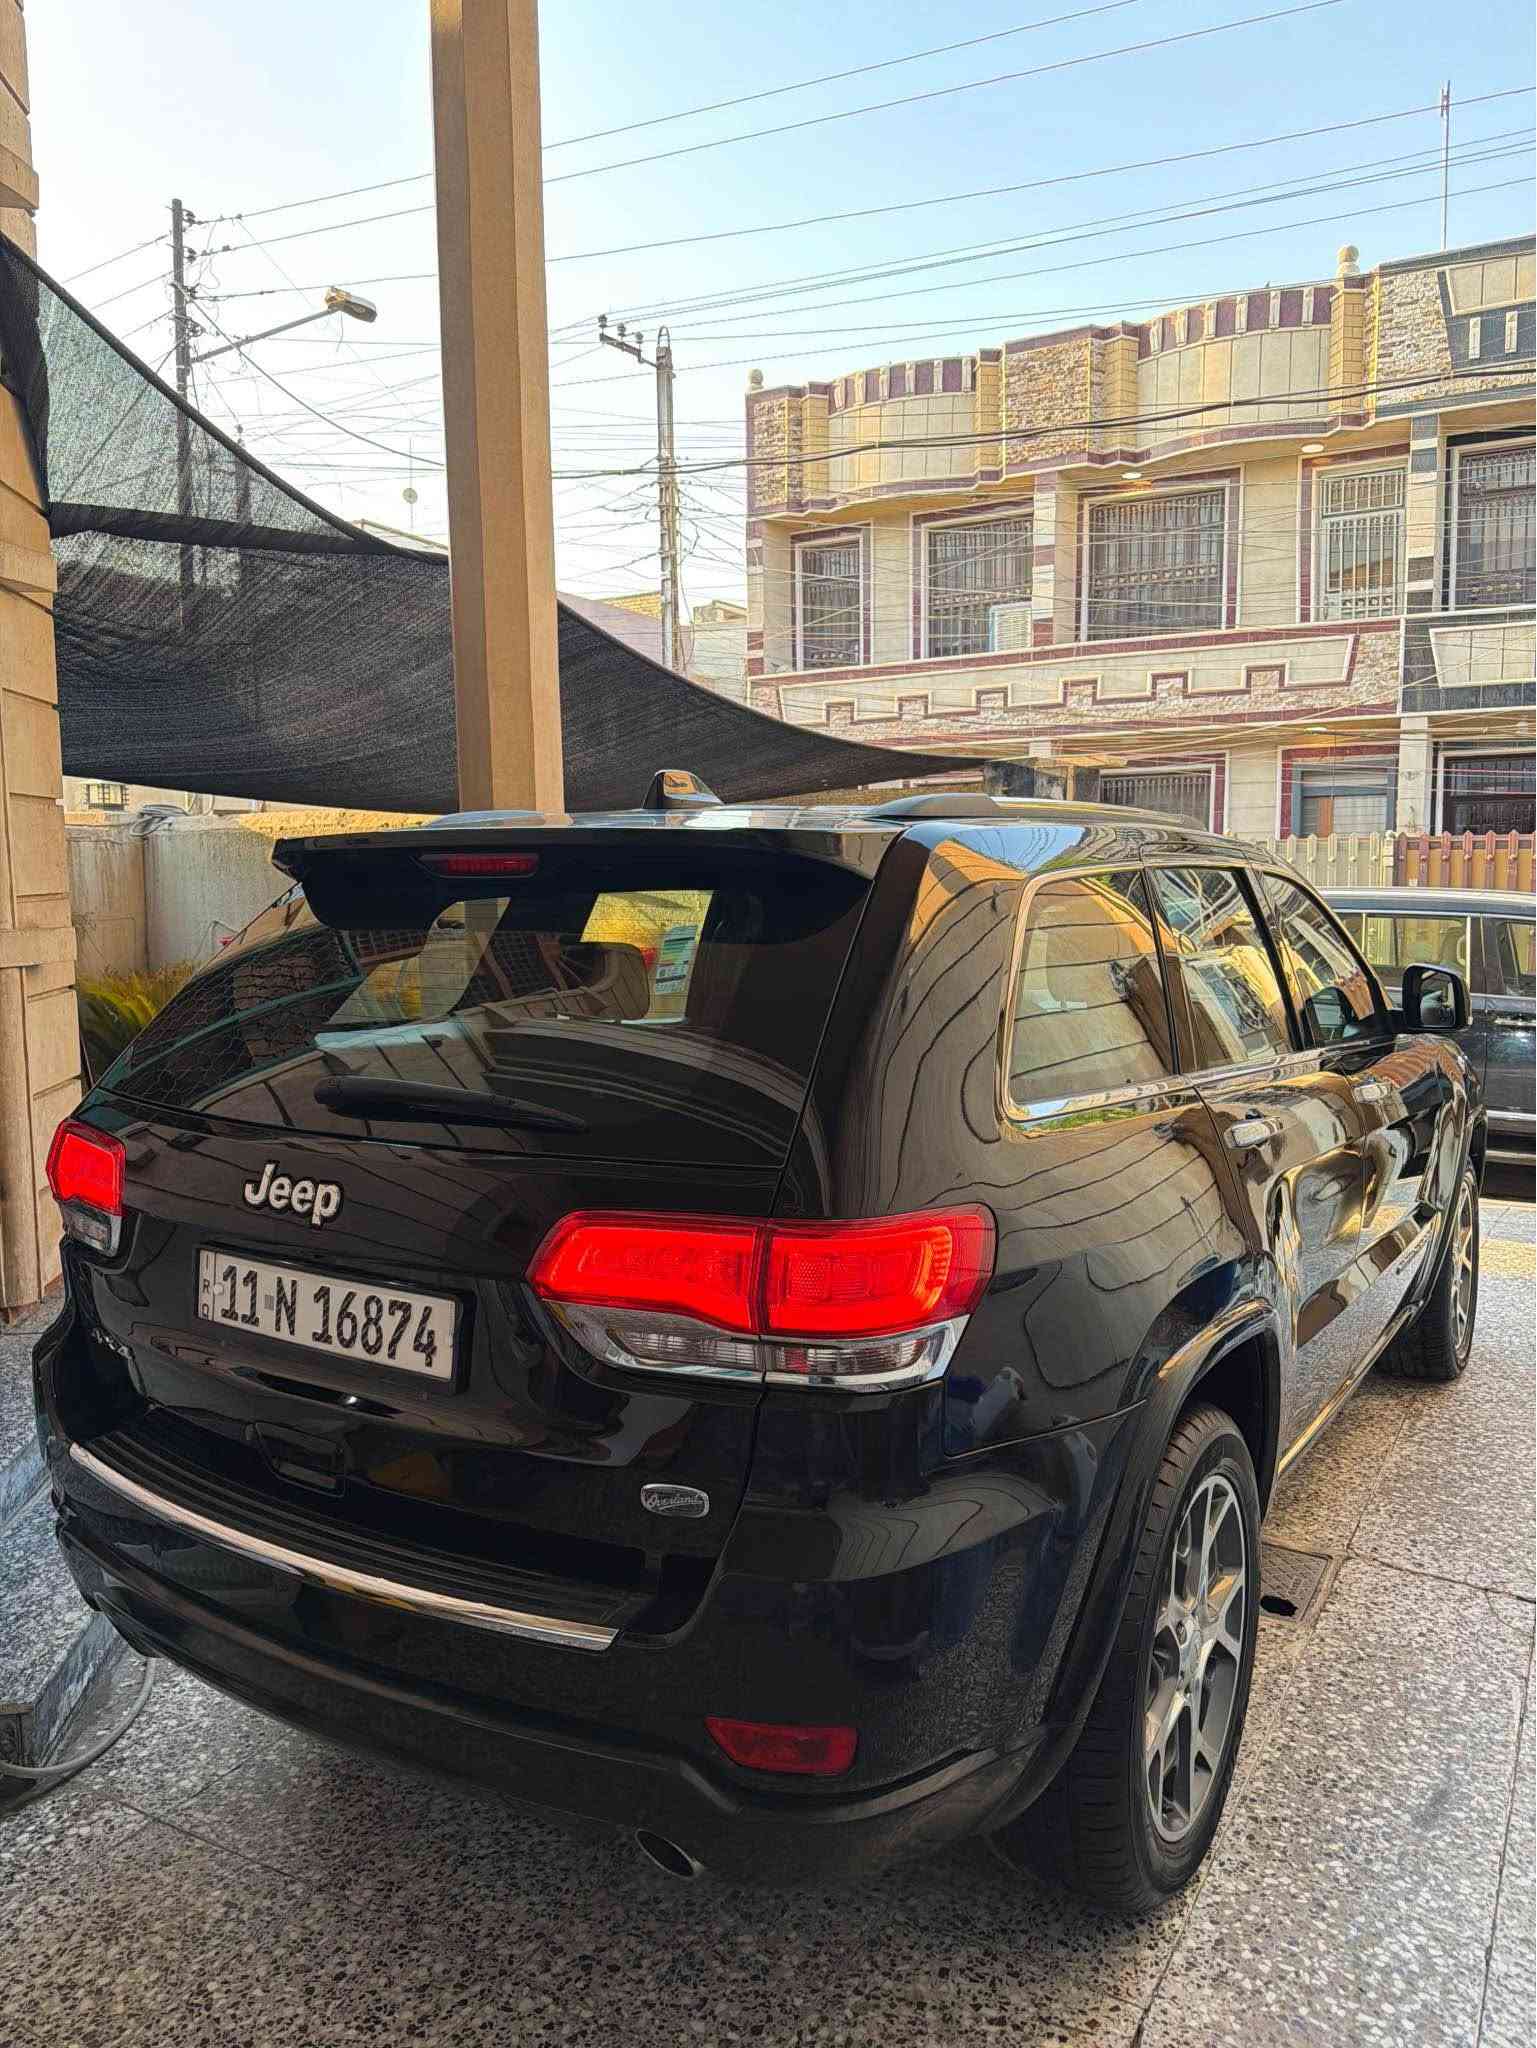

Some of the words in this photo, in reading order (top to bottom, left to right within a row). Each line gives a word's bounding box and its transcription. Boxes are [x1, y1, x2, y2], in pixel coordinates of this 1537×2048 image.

[243, 1162, 342, 1225] Jeep
[201, 1254, 210, 1318] IRQ
[220, 1264, 260, 1327] 11
[274, 1276, 298, 1337] N
[311, 1285, 438, 1368] 16874
